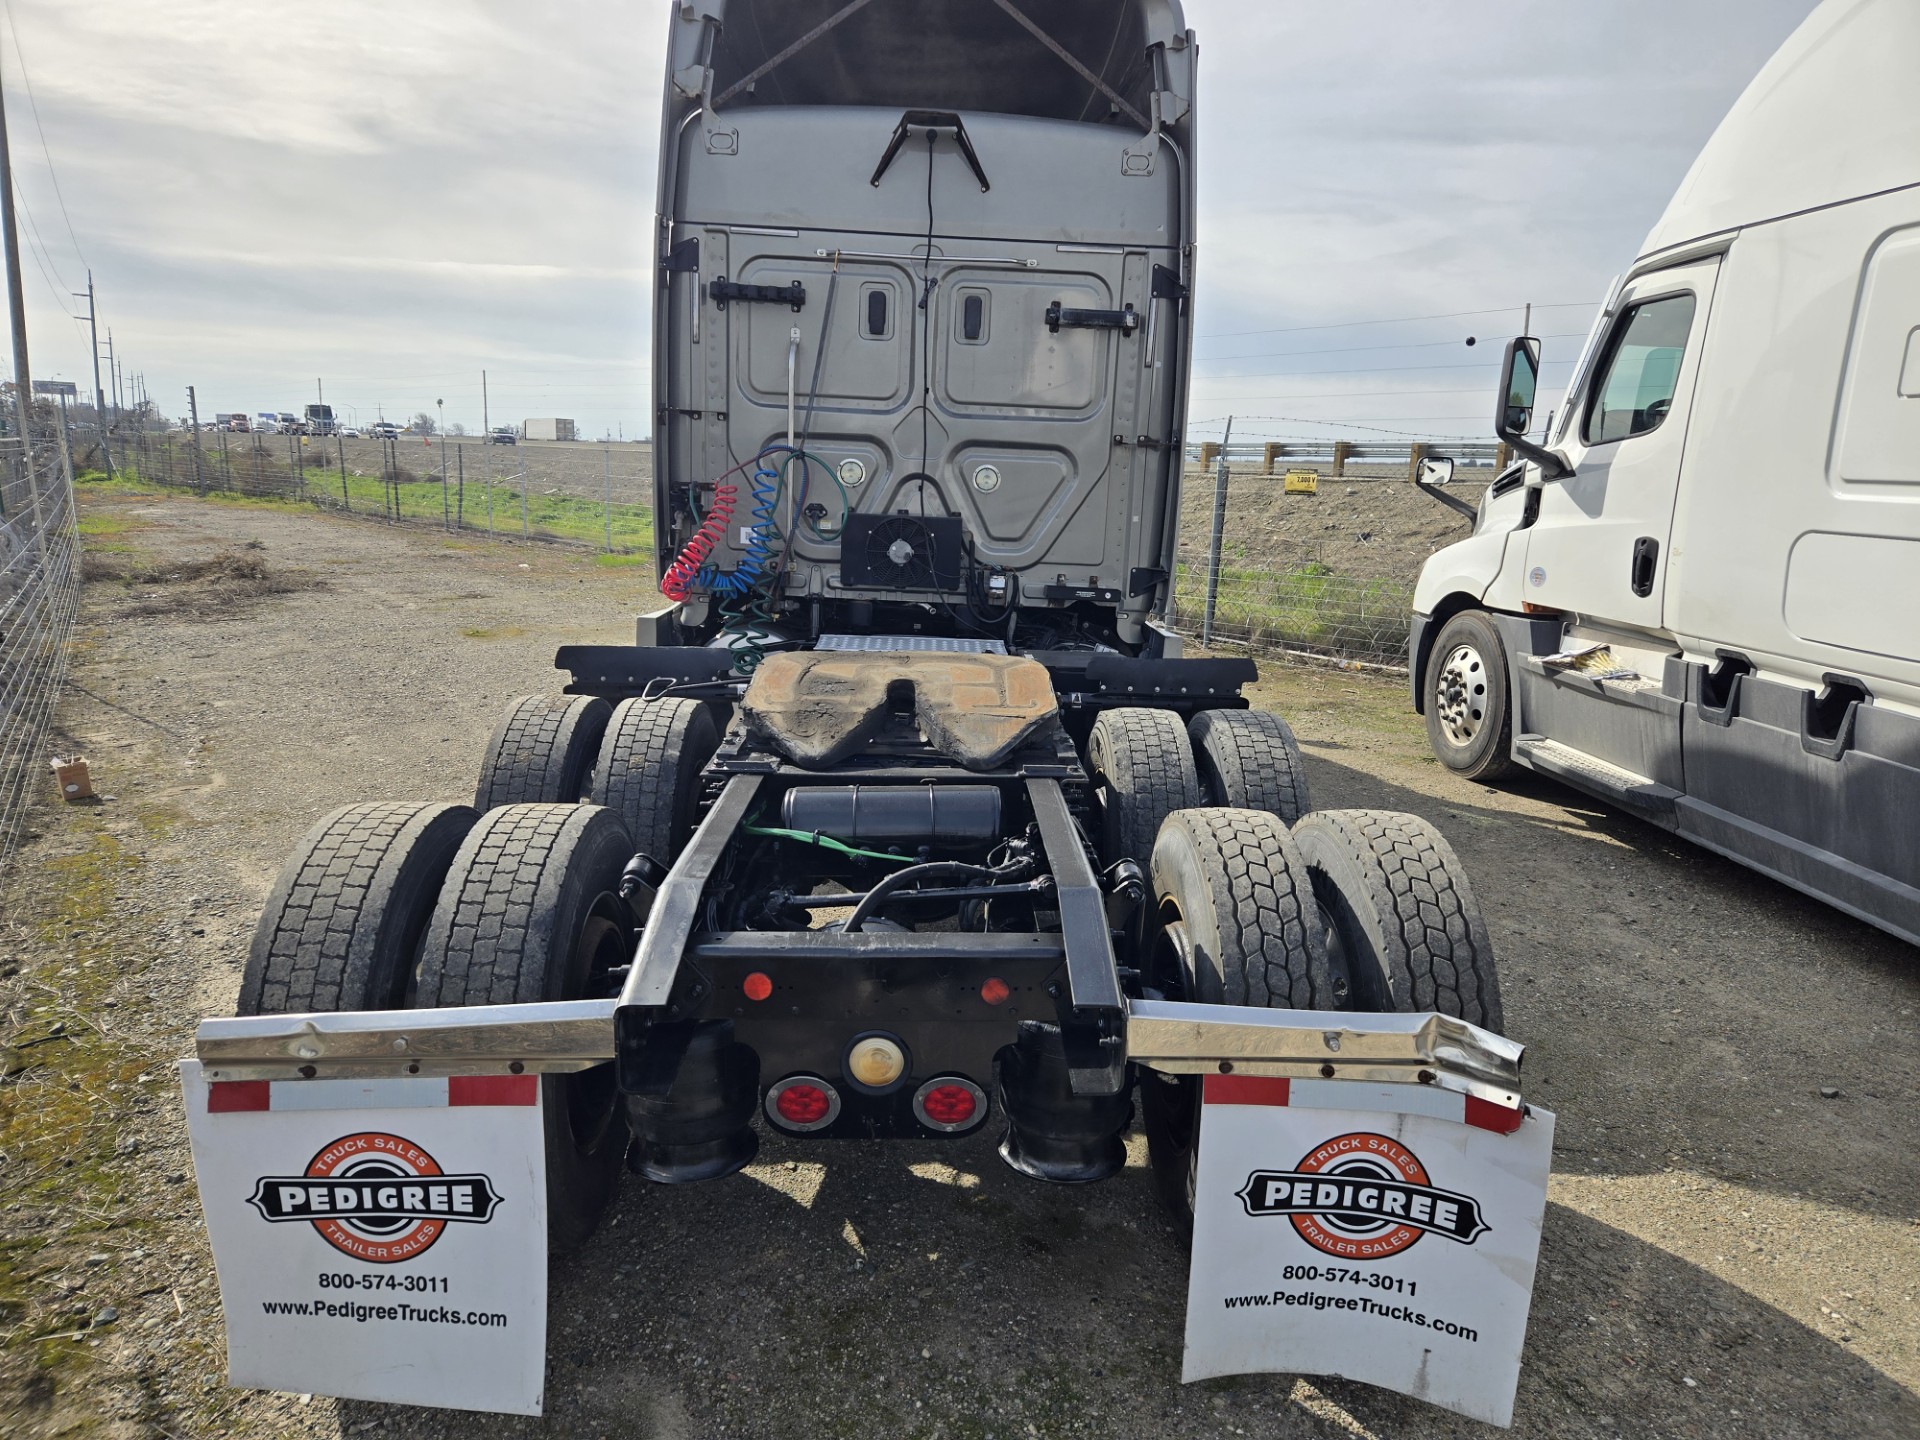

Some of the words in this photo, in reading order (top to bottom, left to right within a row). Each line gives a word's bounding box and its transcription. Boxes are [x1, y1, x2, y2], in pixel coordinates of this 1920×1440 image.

[315, 1138, 368, 1172] TRUCK
[374, 1138, 428, 1168] SALES
[1306, 1138, 1361, 1168] TRUCK
[1368, 1139, 1418, 1176] SALES
[278, 1184, 474, 1213] PEDIGREE
[1264, 1180, 1460, 1231] PEDIGREE
[326, 1224, 388, 1257] TRAILER
[392, 1224, 434, 1257] SALES
[1301, 1219, 1357, 1255] TRAILER
[1361, 1229, 1410, 1255] SALES
[318, 1273, 449, 1293] 800-574-3011
[1282, 1265, 1416, 1297] 800-574-3011
[262, 1301, 507, 1327] www.PedigreeTrucks.com
[1224, 1291, 1478, 1342] www.PedigreeTrucks.com
